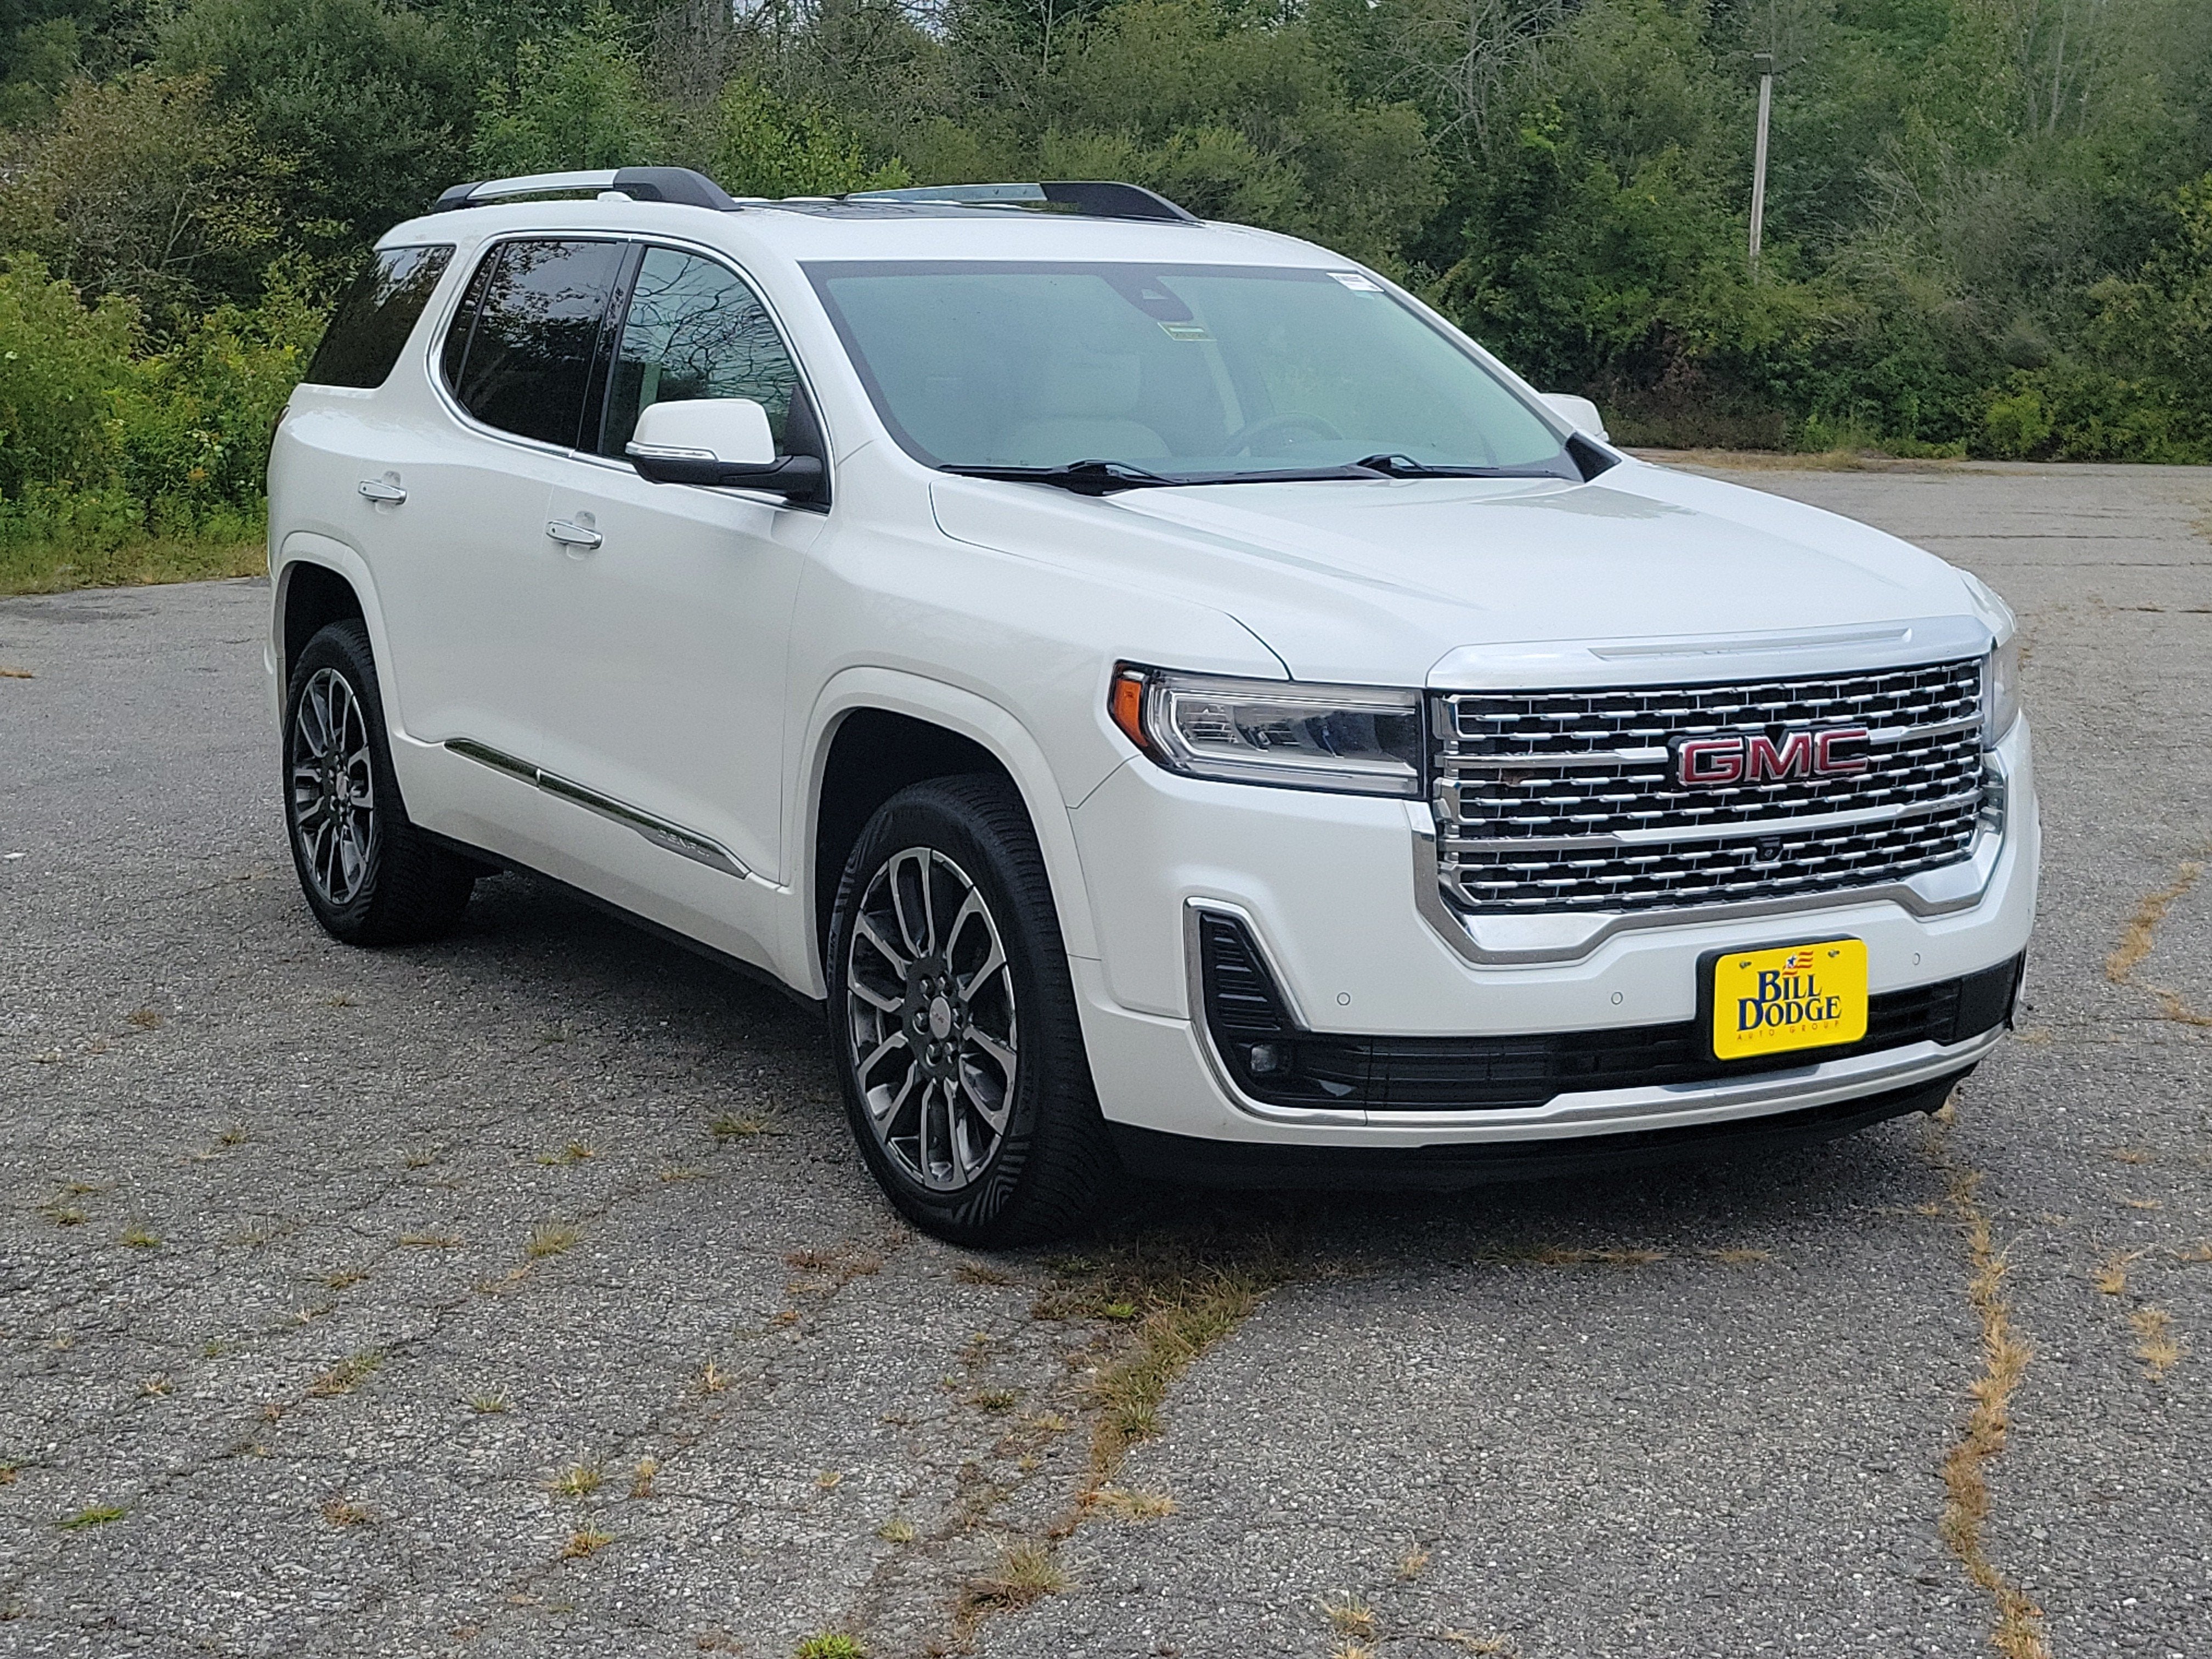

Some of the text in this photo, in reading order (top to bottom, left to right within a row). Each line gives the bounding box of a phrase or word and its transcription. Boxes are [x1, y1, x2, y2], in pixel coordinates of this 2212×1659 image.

[1679, 729, 1869, 786] GMC
[1757, 970, 1822, 1003] BILL
[1737, 996, 1842, 1031] DODGE
[1737, 1021, 1839, 1040] AUTO GROUP
